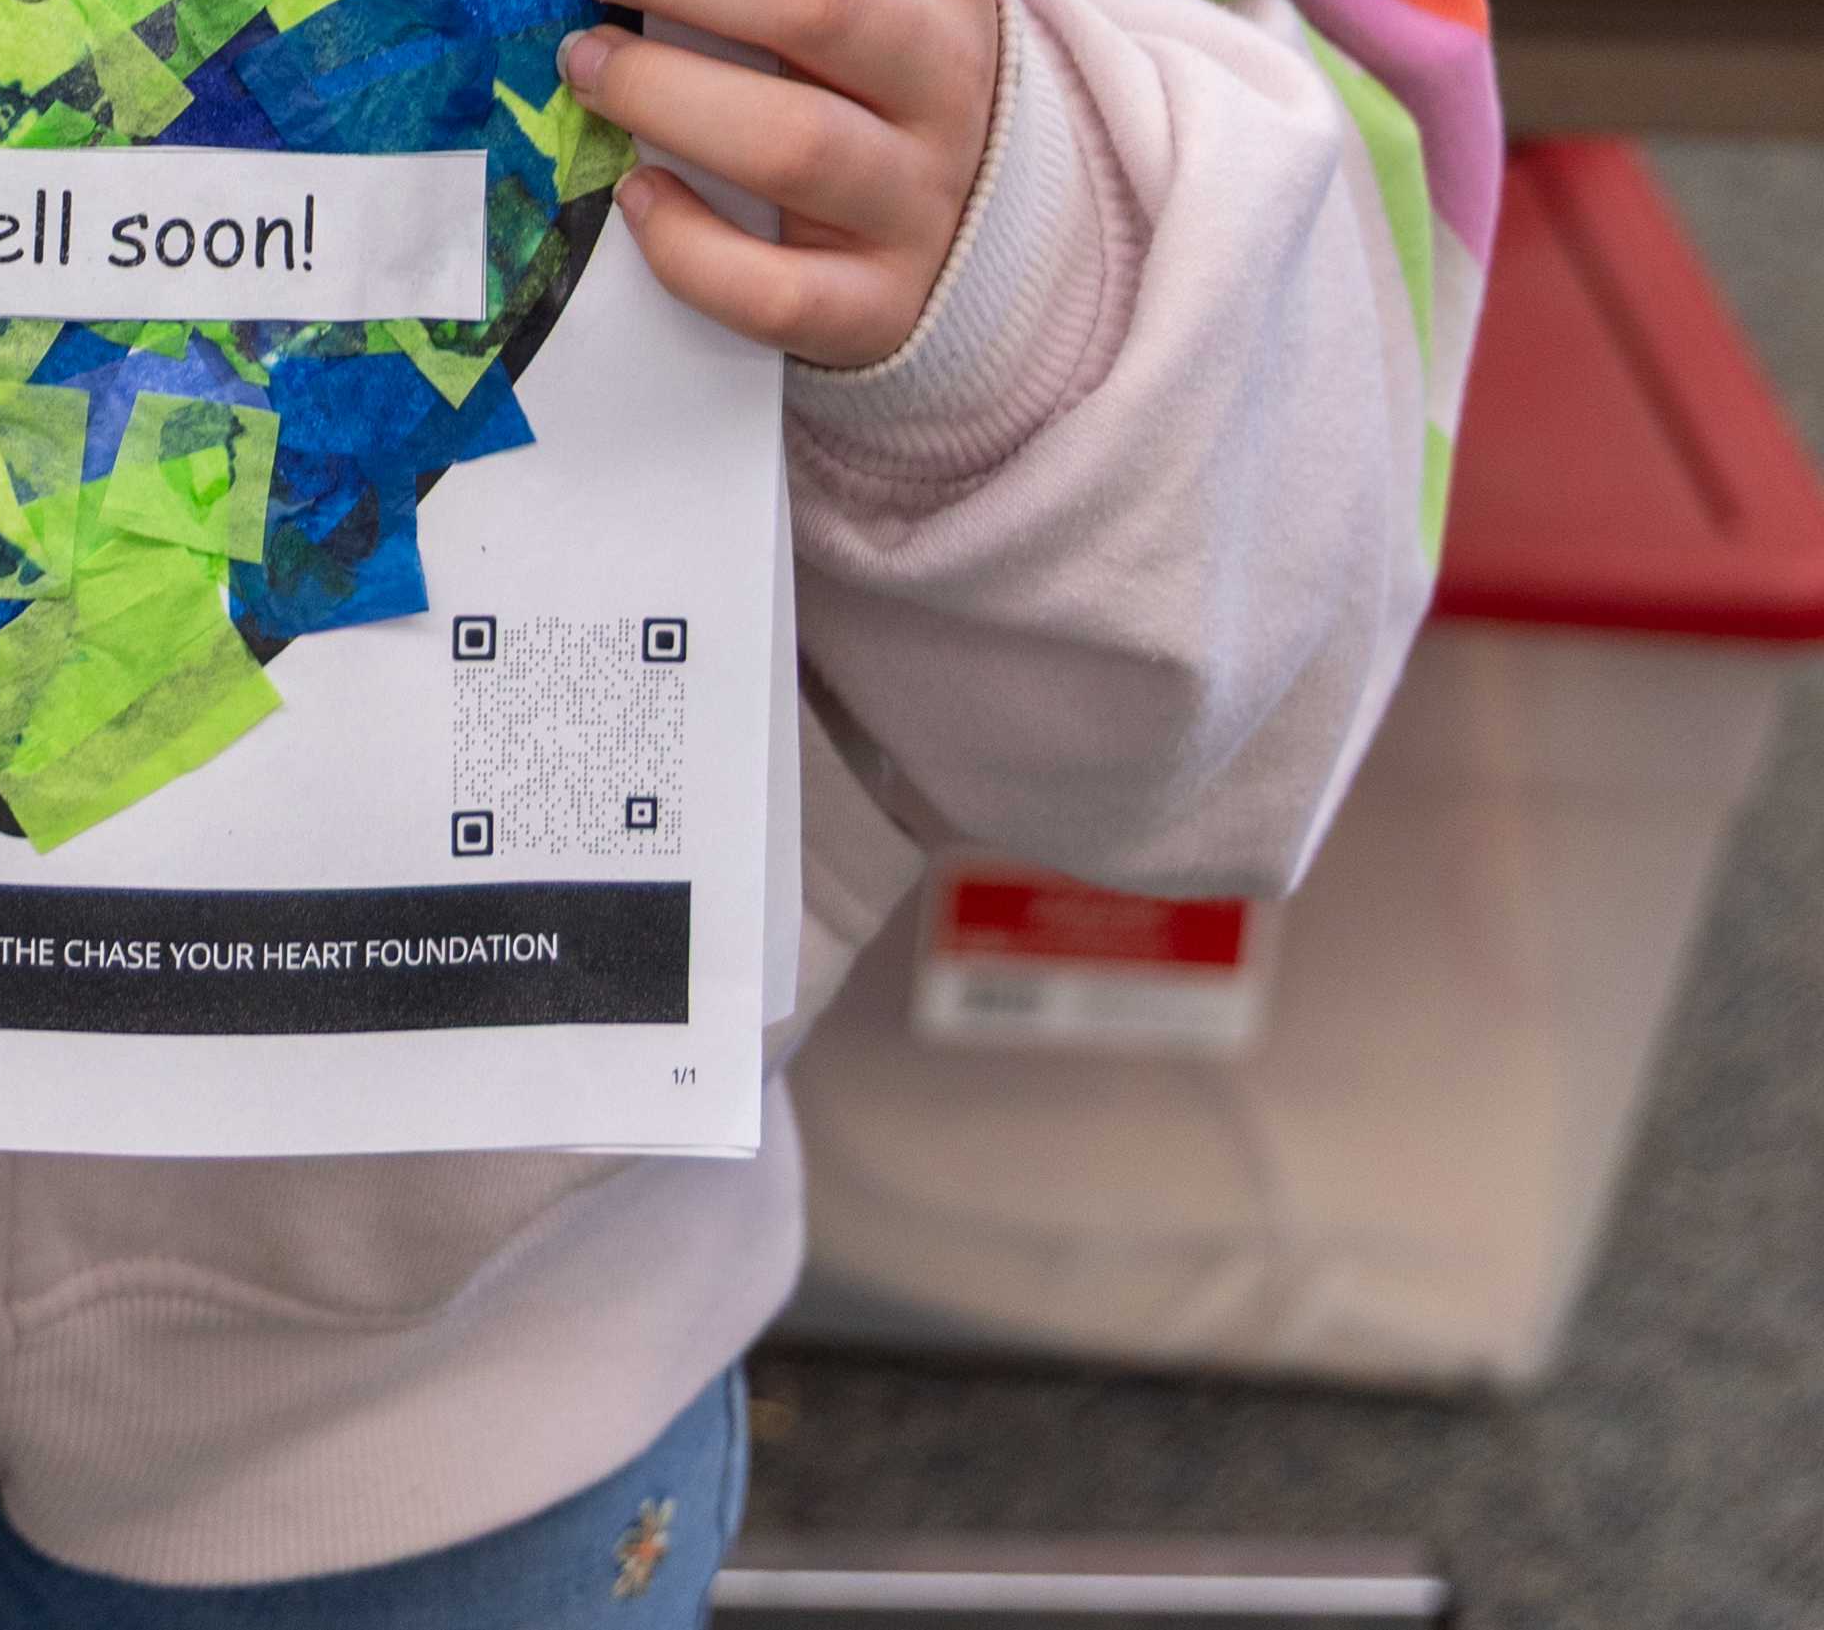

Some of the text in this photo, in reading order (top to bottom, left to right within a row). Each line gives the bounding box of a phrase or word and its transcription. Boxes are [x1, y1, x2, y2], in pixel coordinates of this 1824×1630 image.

[107, 193, 315, 273] soon!
[63, 939, 161, 970] CHASE
[169, 941, 255, 971] YOUR
[262, 940, 358, 971] HEART
[365, 932, 559, 968] FOUNDATION
[672, 1067, 696, 1086] 1/1
